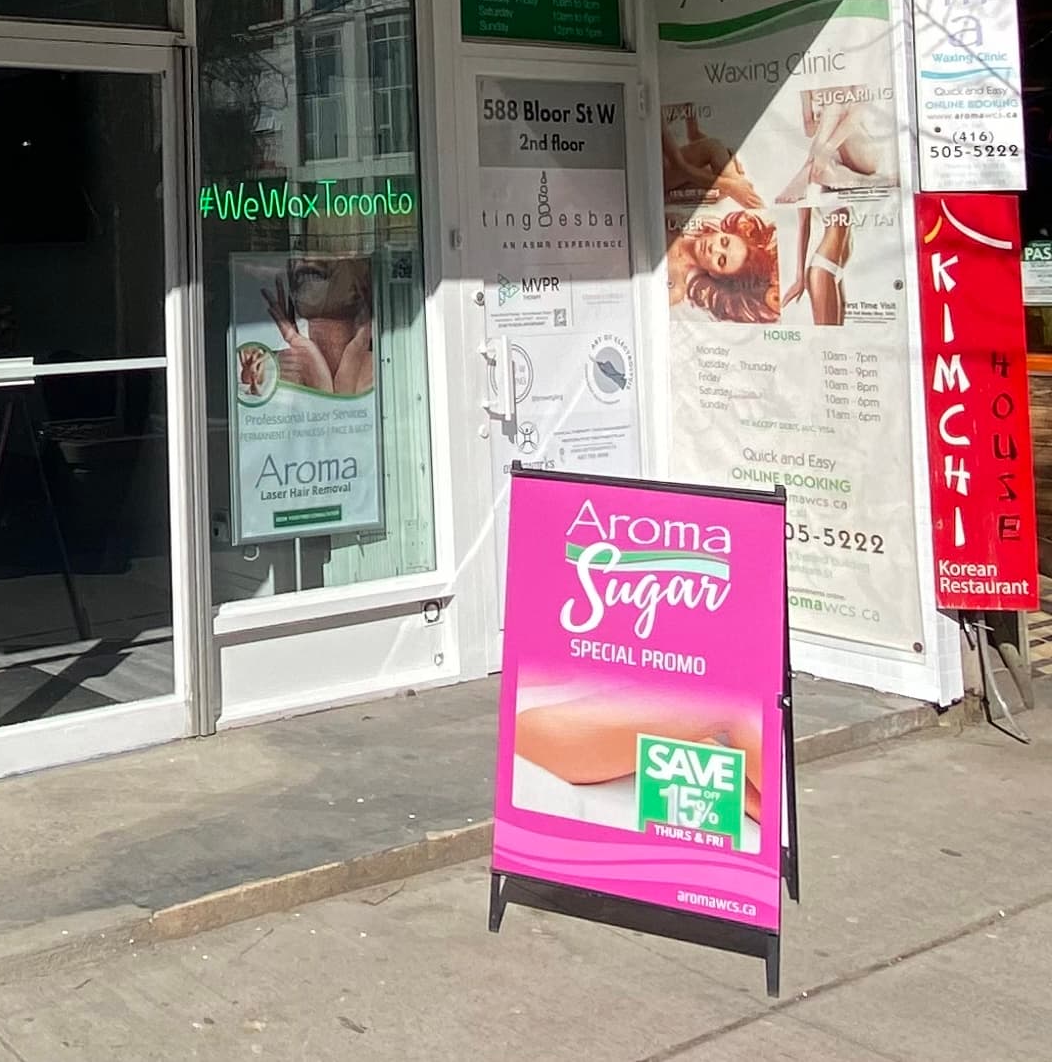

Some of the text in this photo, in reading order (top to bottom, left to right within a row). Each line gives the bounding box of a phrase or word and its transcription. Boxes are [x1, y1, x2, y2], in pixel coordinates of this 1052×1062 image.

[705, 48, 846, 84] Waxing Clinic
[932, 52, 1008, 63] Waxing Clinic
[934, 86, 1007, 97] Quick and Easy
[483, 99, 615, 124] 588 Bloor St W
[925, 100, 965, 109] ONLINE
[520, 134, 585, 152] 2nd floor
[952, 131, 995, 144] (416)
[930, 144, 1019, 158] 505-5222
[199, 179, 414, 221] #WeWaxToronto
[558, 240, 624, 249] EXPERIENCE
[1024, 247, 1052, 260] PAS
[521, 276, 560, 293] MVPR
[764, 330, 801, 341] HOURS
[696, 345, 878, 364] Monday 10am 7pm
[698, 371, 721, 383] Friday
[825, 379, 849, 390] 10am
[824, 365, 848, 376] 10am
[855, 366, 878, 379] 9pm
[825, 394, 849, 405] 10am
[931, 252, 971, 547] KIMCHI
[245, 409, 368, 427] Professional Laser Services
[699, 399, 729, 411] Sunday
[826, 408, 850, 420] 11am
[990, 352, 1022, 543] HOUSE
[743, 447, 837, 472] Quick and Easy
[255, 453, 358, 489] Aroma
[732, 467, 852, 493] ONLINE BOOKING
[260, 482, 351, 501] Laser Hair Removal
[788, 493, 848, 510] mawcs.ca
[566, 499, 732, 554] Aroma
[785, 522, 885, 554] 05-5222
[939, 559, 997, 576] Korean
[559, 542, 732, 639] Sugar
[939, 577, 1029, 594] Restaurant
[789, 595, 881, 622] omawcs.ca
[570, 638, 706, 676] SPECIAL PROMO
[645, 744, 735, 791] SAVE
[659, 784, 720, 829] 15% OFF
[654, 824, 724, 847] THURS & FRI
[677, 891, 757, 916] aromawcs.ca
